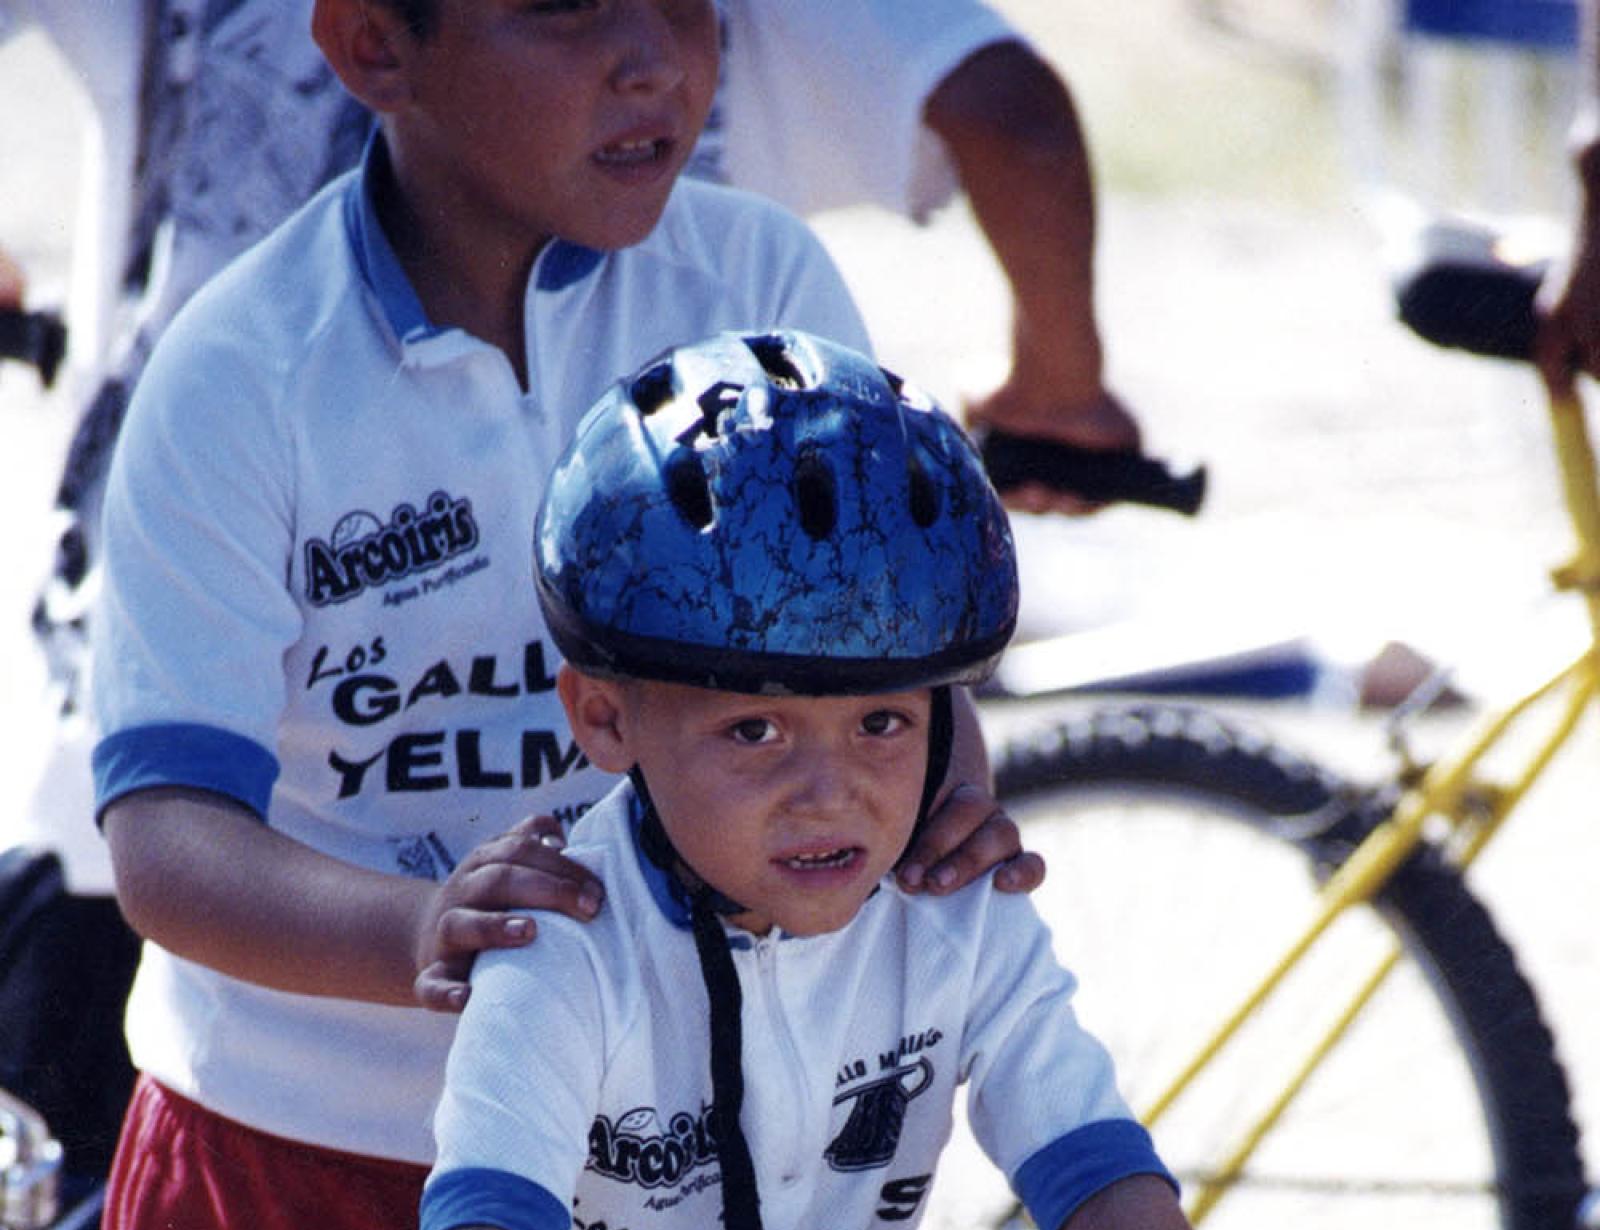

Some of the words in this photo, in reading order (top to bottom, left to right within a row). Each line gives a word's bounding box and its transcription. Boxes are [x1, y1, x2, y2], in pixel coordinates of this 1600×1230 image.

[305, 490, 479, 608] Arcoiris
[331, 641, 560, 727] GALL
[327, 729, 592, 800] YELM
